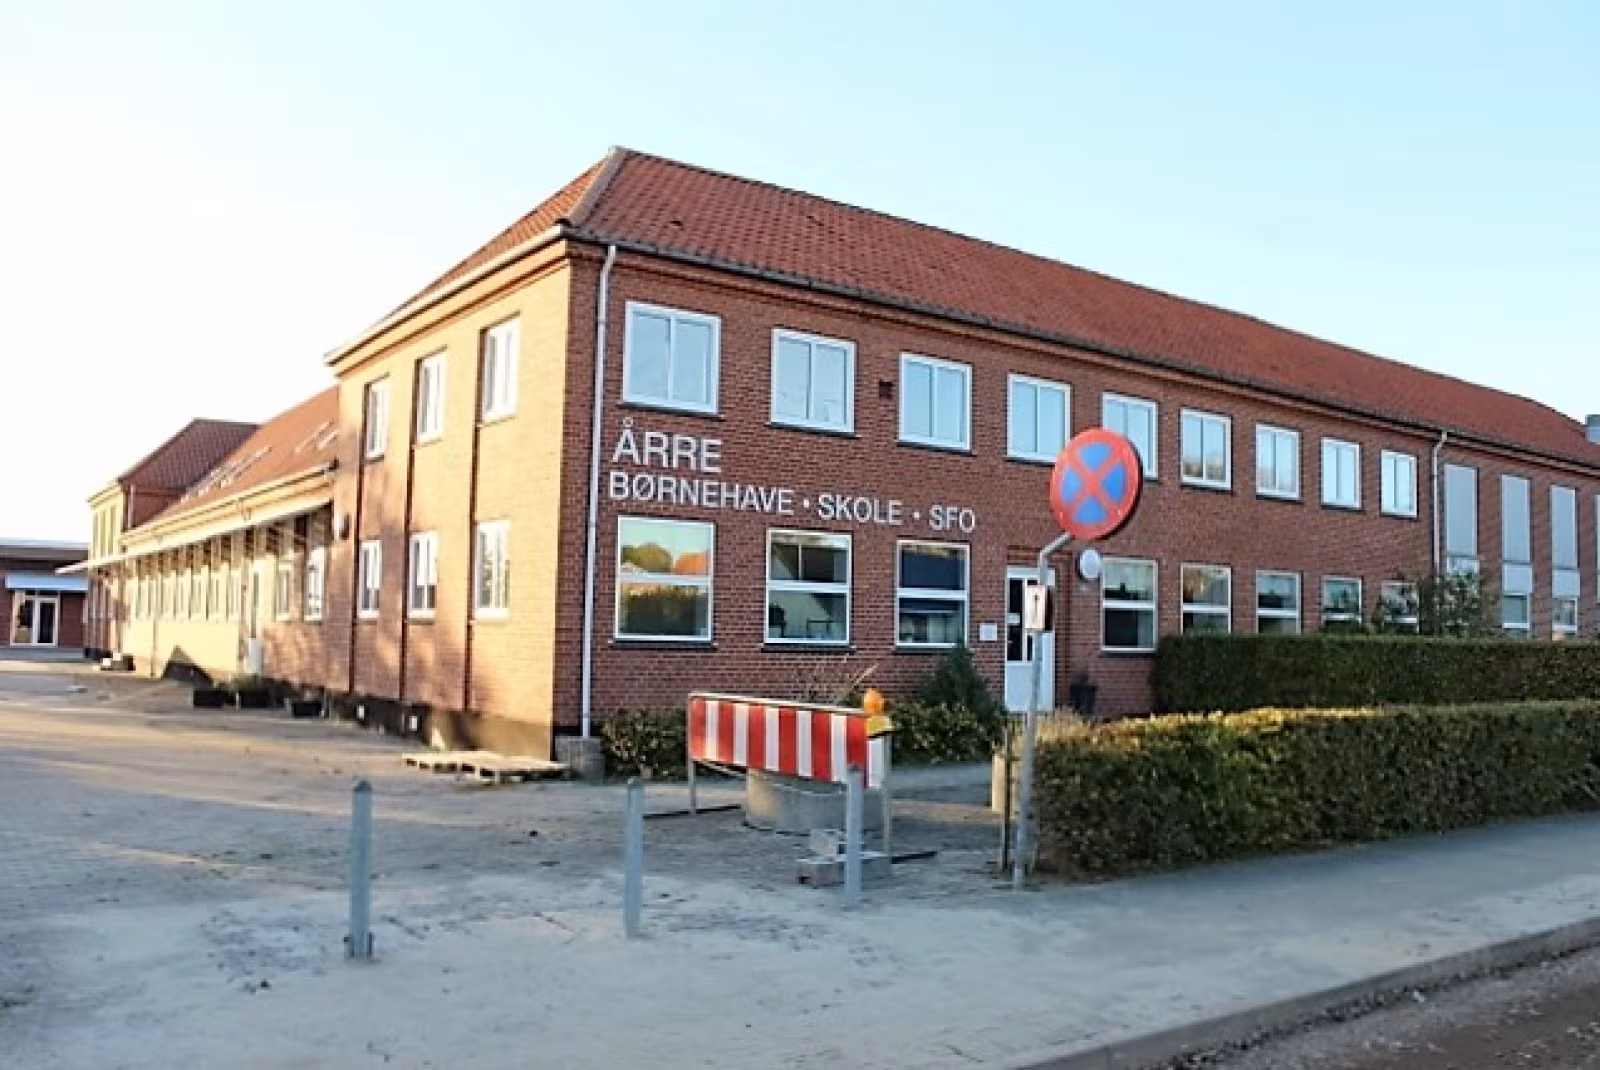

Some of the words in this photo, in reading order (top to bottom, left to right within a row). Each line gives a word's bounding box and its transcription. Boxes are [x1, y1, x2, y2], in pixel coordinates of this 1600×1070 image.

[613, 417, 722, 474] ÅRRE
[609, 470, 794, 516] BØRNEHAVE
[818, 493, 903, 526] SKOLE
[929, 504, 976, 533] SFO
